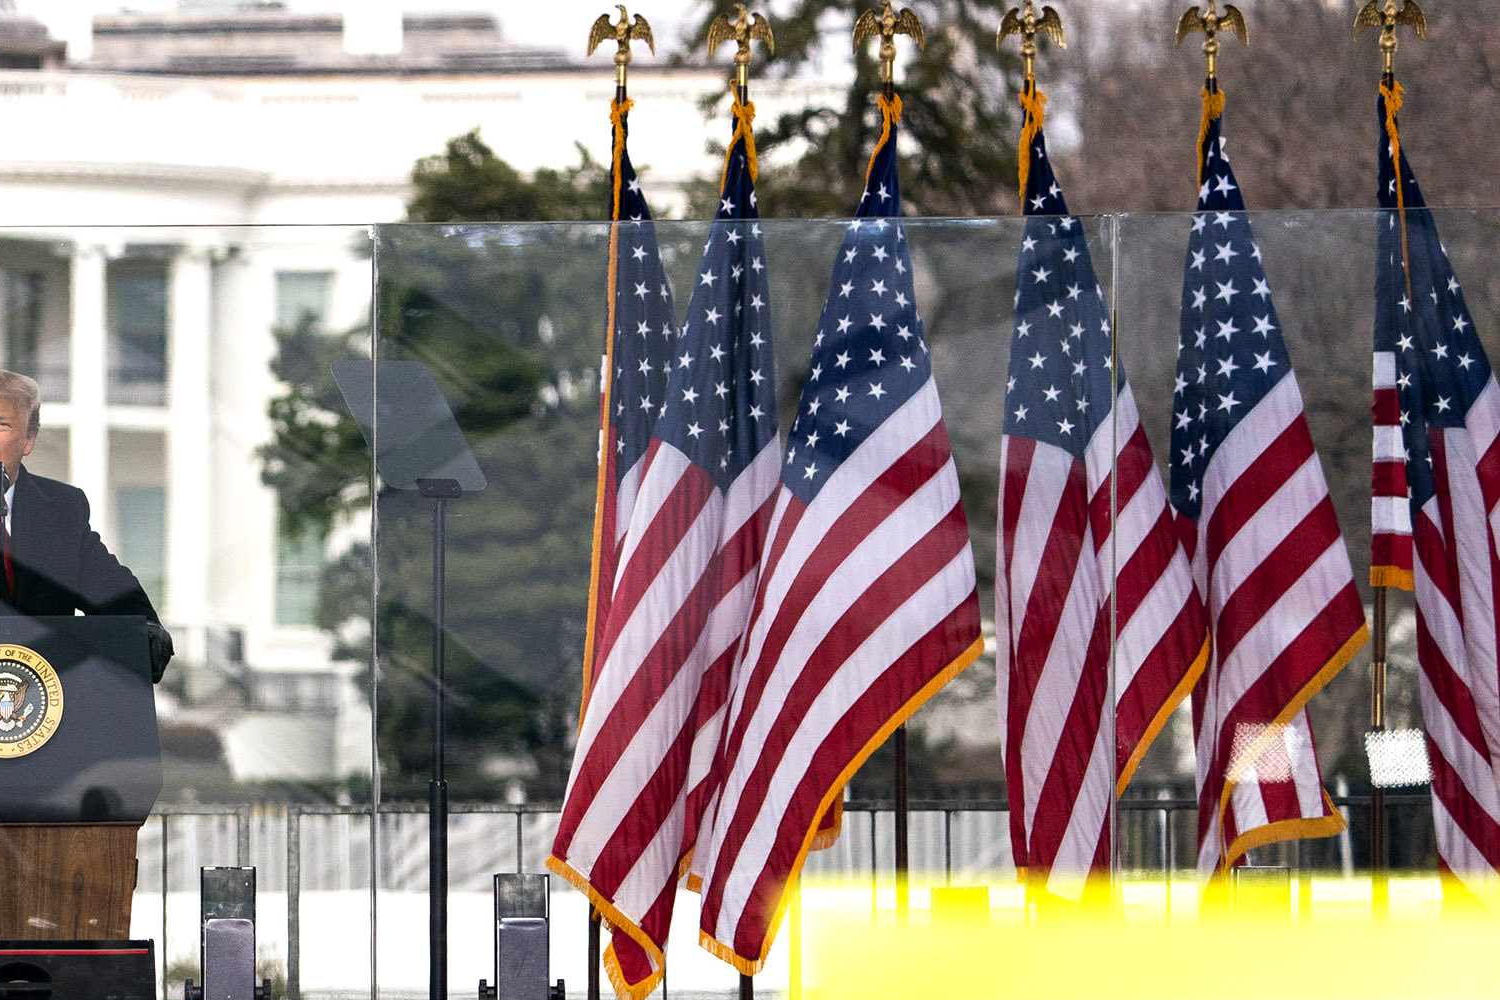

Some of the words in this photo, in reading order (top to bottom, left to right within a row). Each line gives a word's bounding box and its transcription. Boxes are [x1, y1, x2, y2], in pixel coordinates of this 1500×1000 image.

[4, 649, 16, 657] OF
[18, 651, 33, 663] THE
[34, 661, 60, 707] UNITED
[16, 716, 56, 753] STATES
